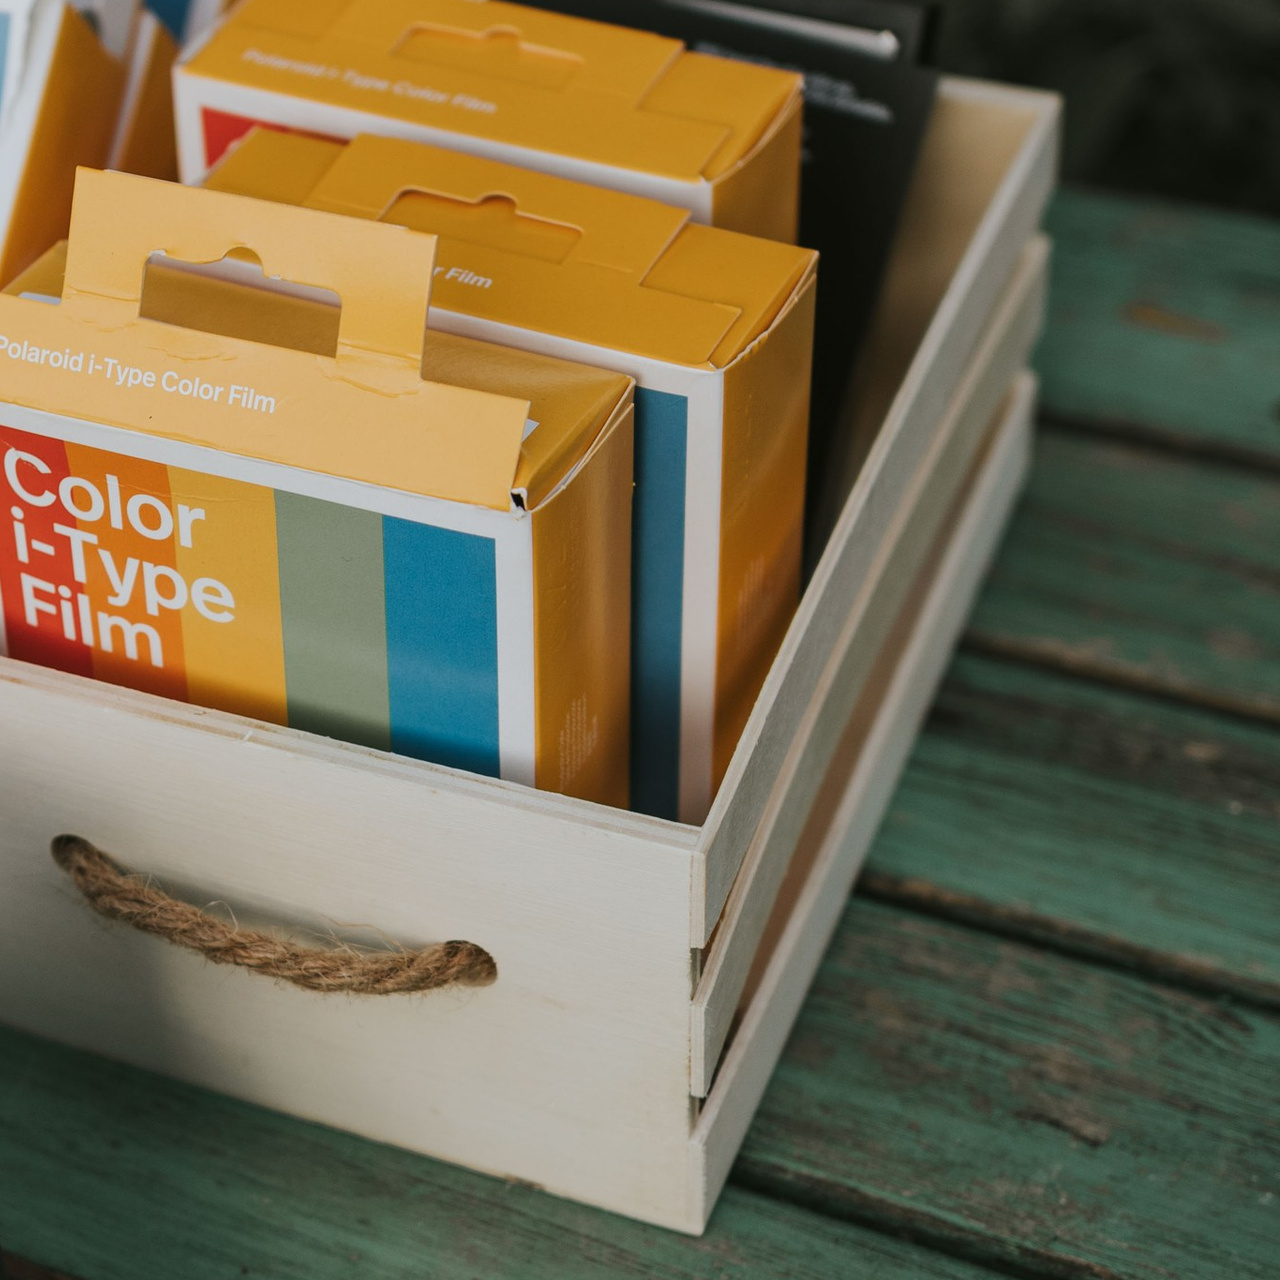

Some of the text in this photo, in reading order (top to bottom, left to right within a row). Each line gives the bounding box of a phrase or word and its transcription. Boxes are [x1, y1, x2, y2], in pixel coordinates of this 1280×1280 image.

[445, 266, 493, 289] Film
[87, 354, 156, 388] i-Type
[161, 371, 224, 401] Color
[228, 385, 276, 413] Film
[4, 447, 206, 548] Color
[11, 506, 236, 623] i-Type
[20, 572, 164, 668] Film
